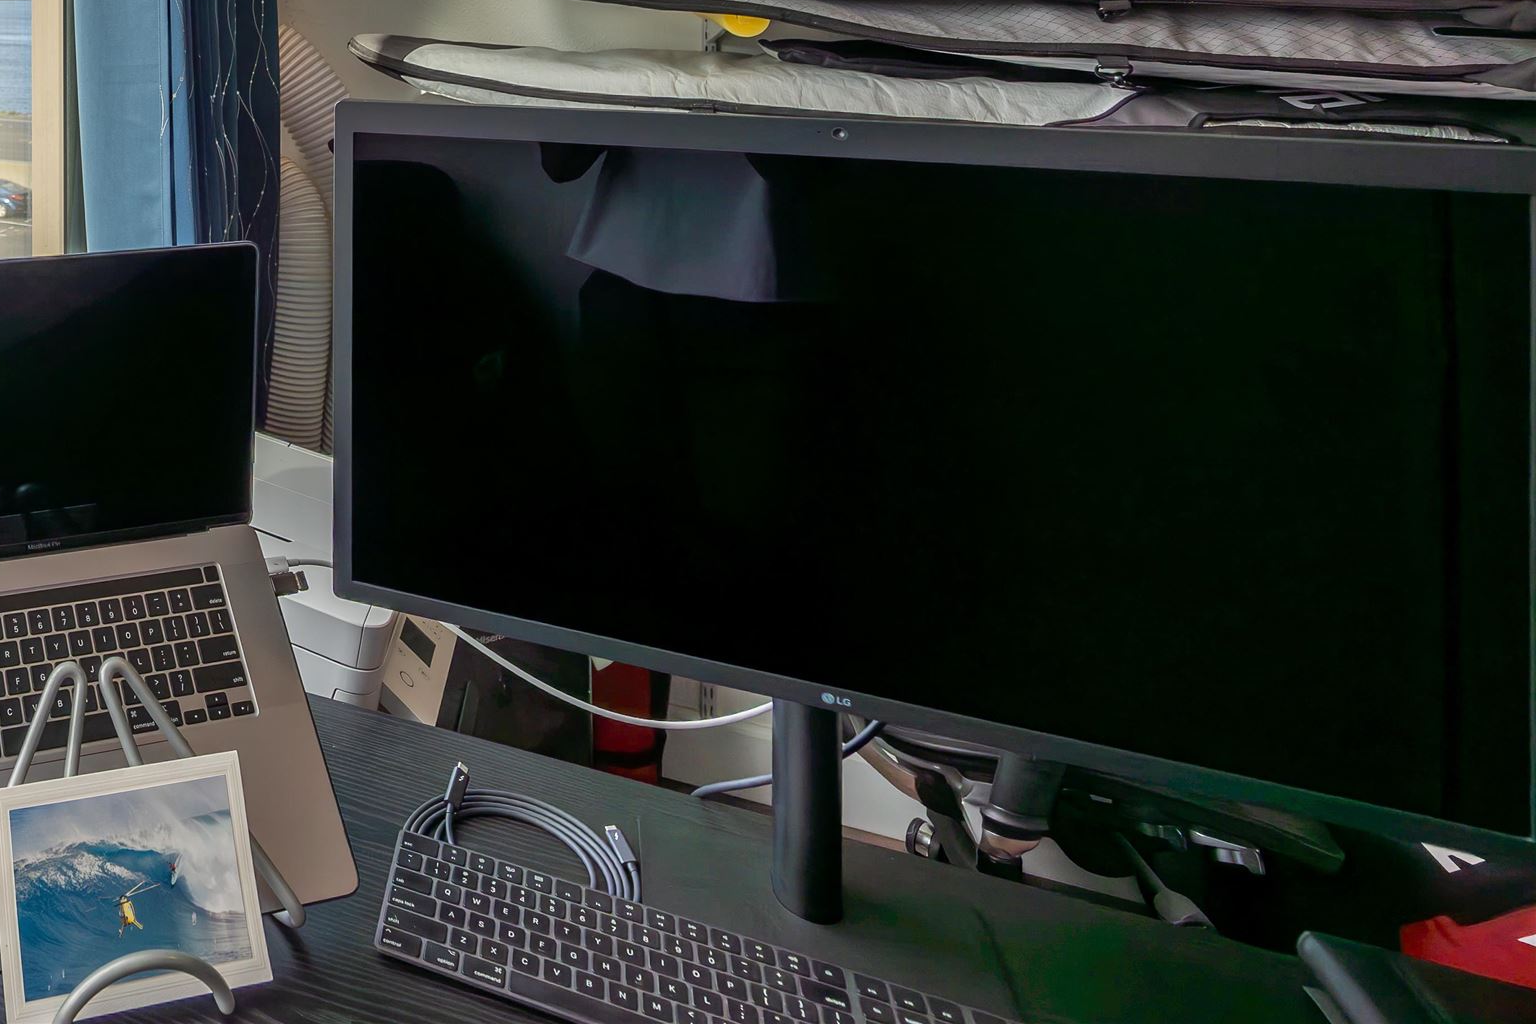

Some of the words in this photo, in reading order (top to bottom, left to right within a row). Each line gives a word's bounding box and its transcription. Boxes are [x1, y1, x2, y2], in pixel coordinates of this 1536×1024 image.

[109, 611, 115, 619] 9
[132, 607, 138, 615] 0
[61, 618, 67, 626] 7
[85, 615, 91, 623] 8
[13, 625, 20, 633] 5
[37, 622, 43, 630] 6
[125, 631, 132, 639] O
[148, 628, 154, 636] P
[77, 639, 84, 647] U
[102, 635, 106, 643] I
[30, 646, 35, 654] T
[53, 642, 59, 650] Y
[4, 650, 10, 658] R
[90, 665, 95, 673] J
[15, 677, 21, 685] F
[40, 673, 46, 681] G
[57, 699, 63, 707] B
[836, 696, 851, 707] LG
[7, 708, 13, 716] C
[444, 888, 451, 896] Q
[472, 897, 481, 905] W
[448, 911, 455, 919] A
[503, 907, 509, 915] E
[478, 920, 485, 928] S
[532, 917, 539, 926] R
[508, 930, 515, 938] D
[564, 927, 570, 935] T
[460, 936, 467, 944] Z
[594, 937, 601, 945] Y
[490, 946, 498, 955] X
[626, 948, 634, 956] U
[570, 951, 577, 959] G
[521, 957, 529, 966] C
[661, 959, 665, 967] I
[602, 962, 610, 970] H
[553, 968, 561, 977] V
[692, 969, 701, 978] O
[473, 969, 501, 985] command
[636, 974, 642, 982] J
[586, 979, 593, 988] B
[726, 980, 734, 989] P
[668, 984, 676, 994] K
[618, 990, 627, 1000] N
[703, 995, 711, 1006] L
[652, 1002, 662, 1012] M
